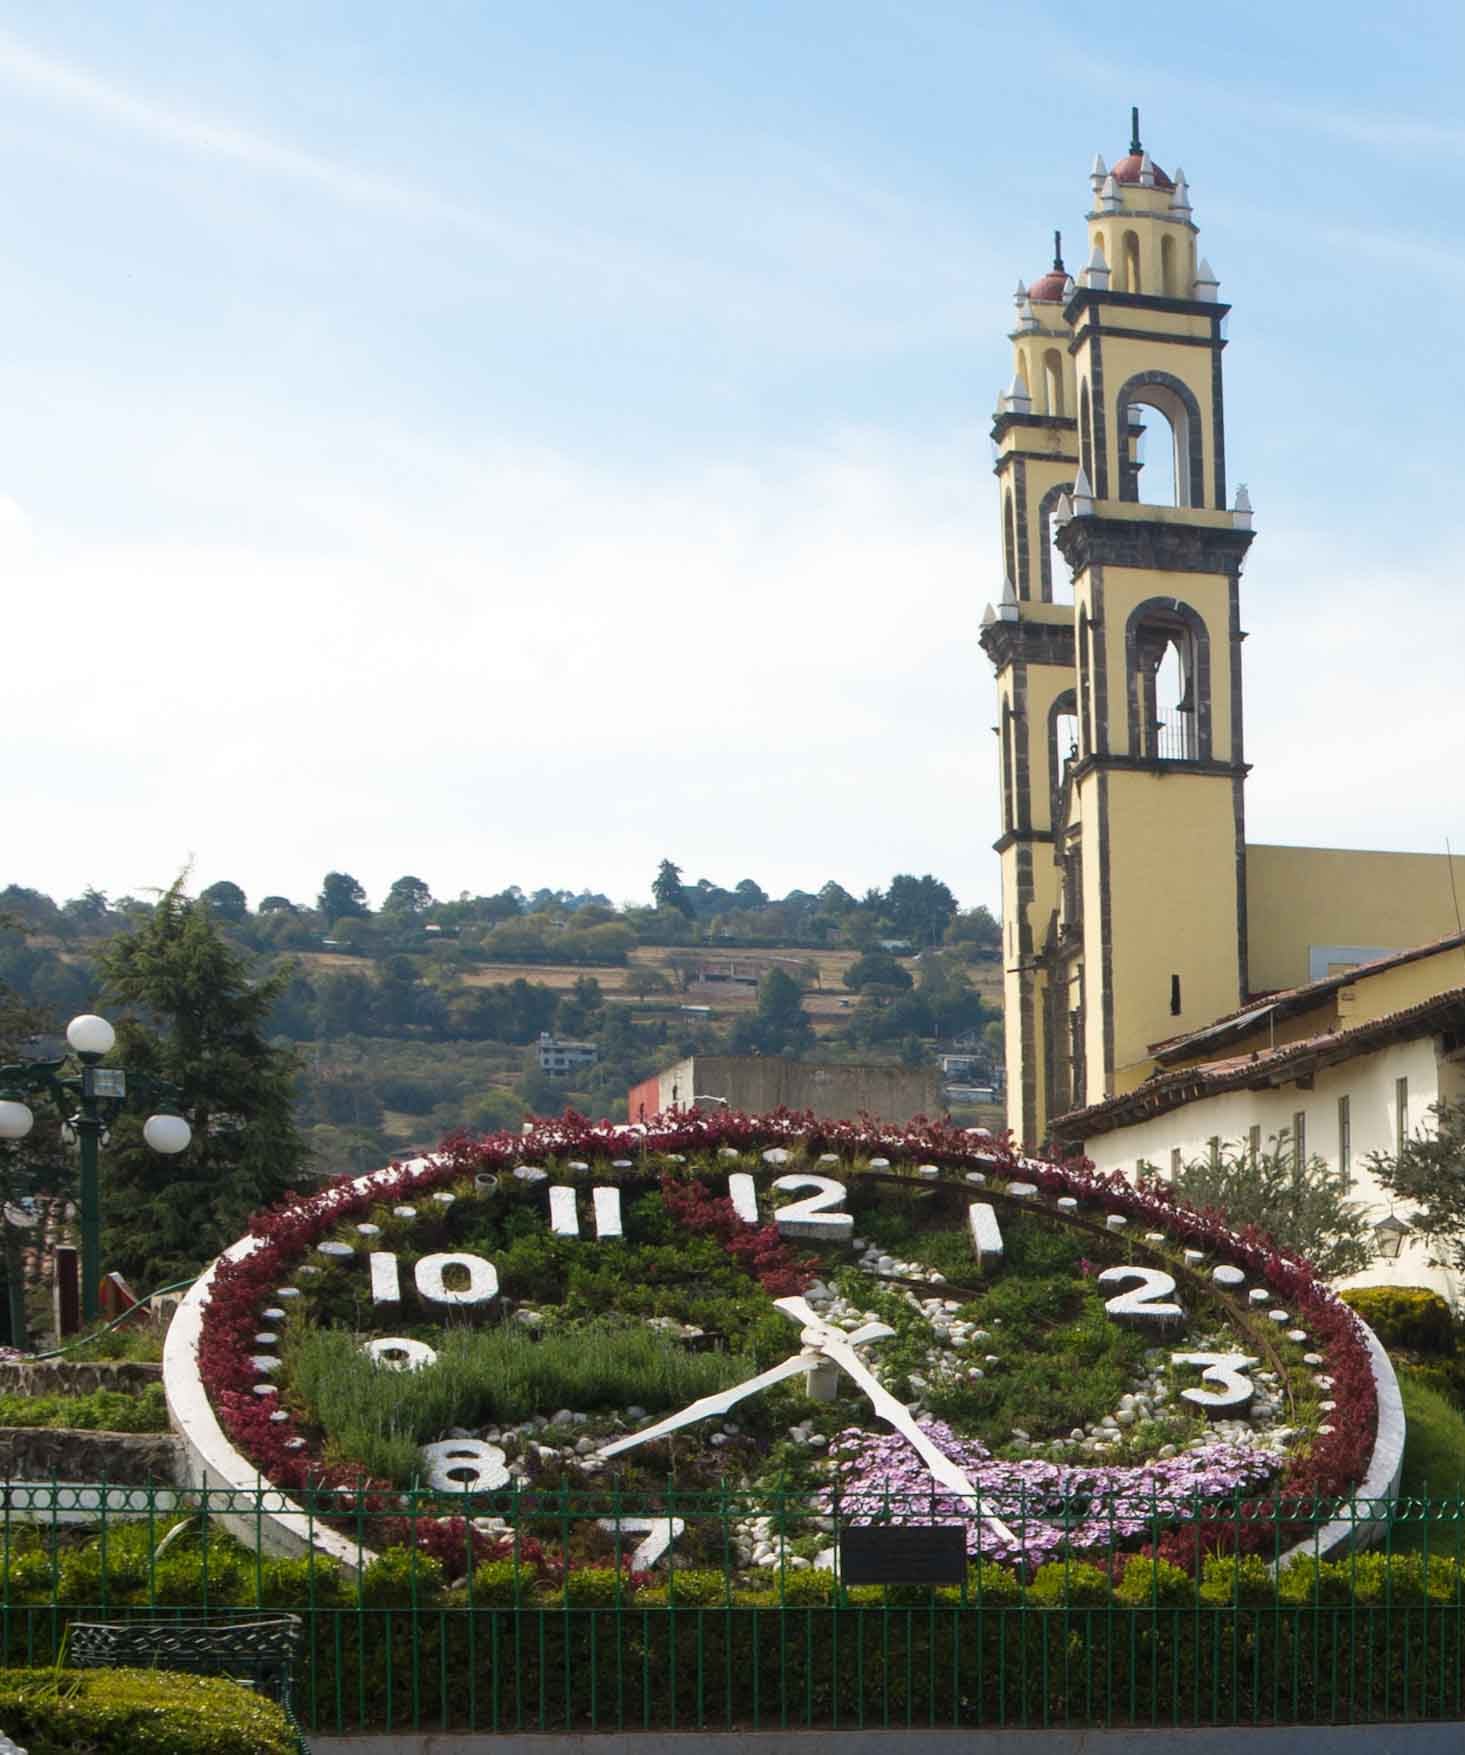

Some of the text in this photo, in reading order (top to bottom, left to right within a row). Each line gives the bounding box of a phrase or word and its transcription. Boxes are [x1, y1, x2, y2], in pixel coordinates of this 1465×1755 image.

[548, 1185, 623, 1236] 11
[728, 1172, 854, 1223] 12
[969, 1202, 1004, 1252] 1
[369, 1251, 499, 1304] 10
[1098, 1266, 1184, 1316] 2
[1171, 1352, 1259, 1406] 3
[424, 1439, 511, 1493] 8
[597, 1517, 685, 1573] 7
